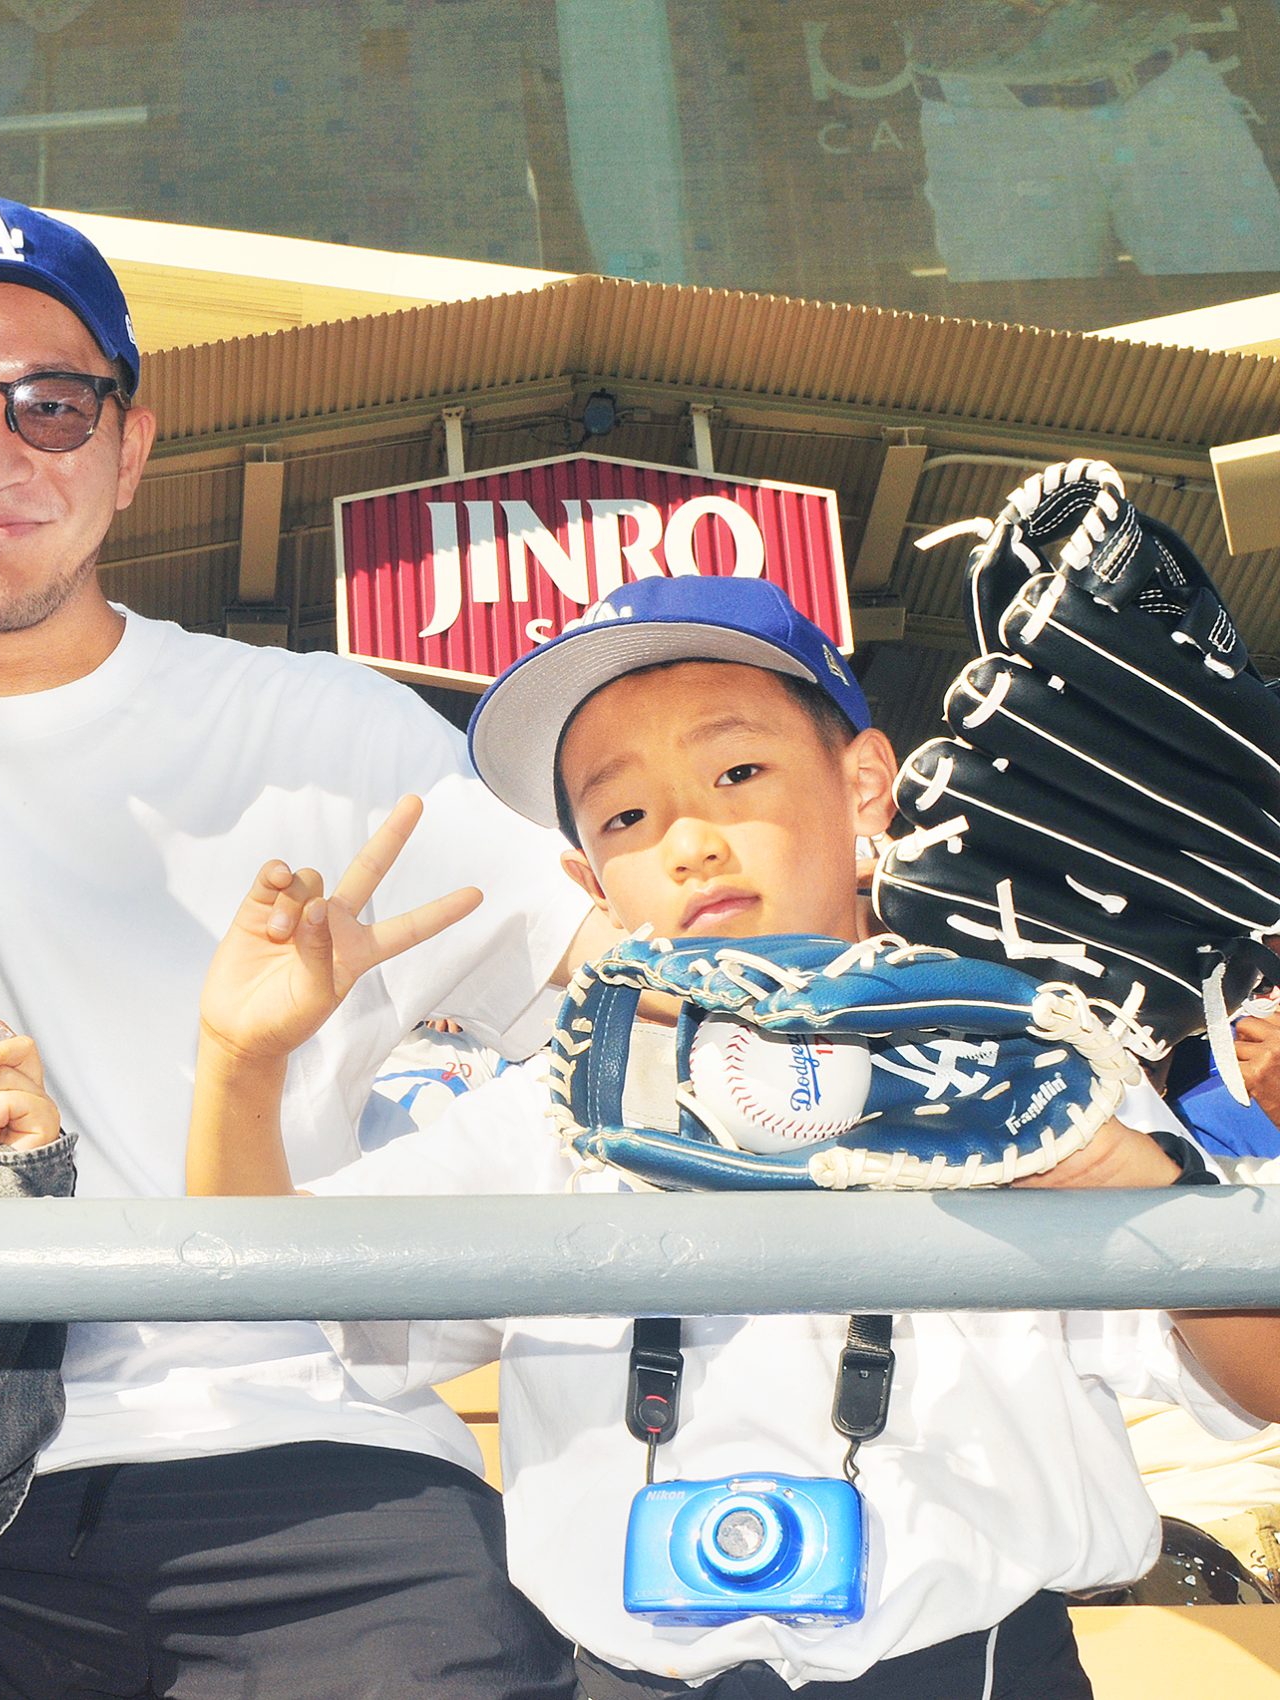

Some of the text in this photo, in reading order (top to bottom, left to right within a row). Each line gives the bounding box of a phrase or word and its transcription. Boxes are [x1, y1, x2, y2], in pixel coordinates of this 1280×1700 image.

[418, 495, 764, 637] JINRO
[1005, 1077, 1068, 1136] Franklin
[645, 1490, 686, 1502] Nikon
